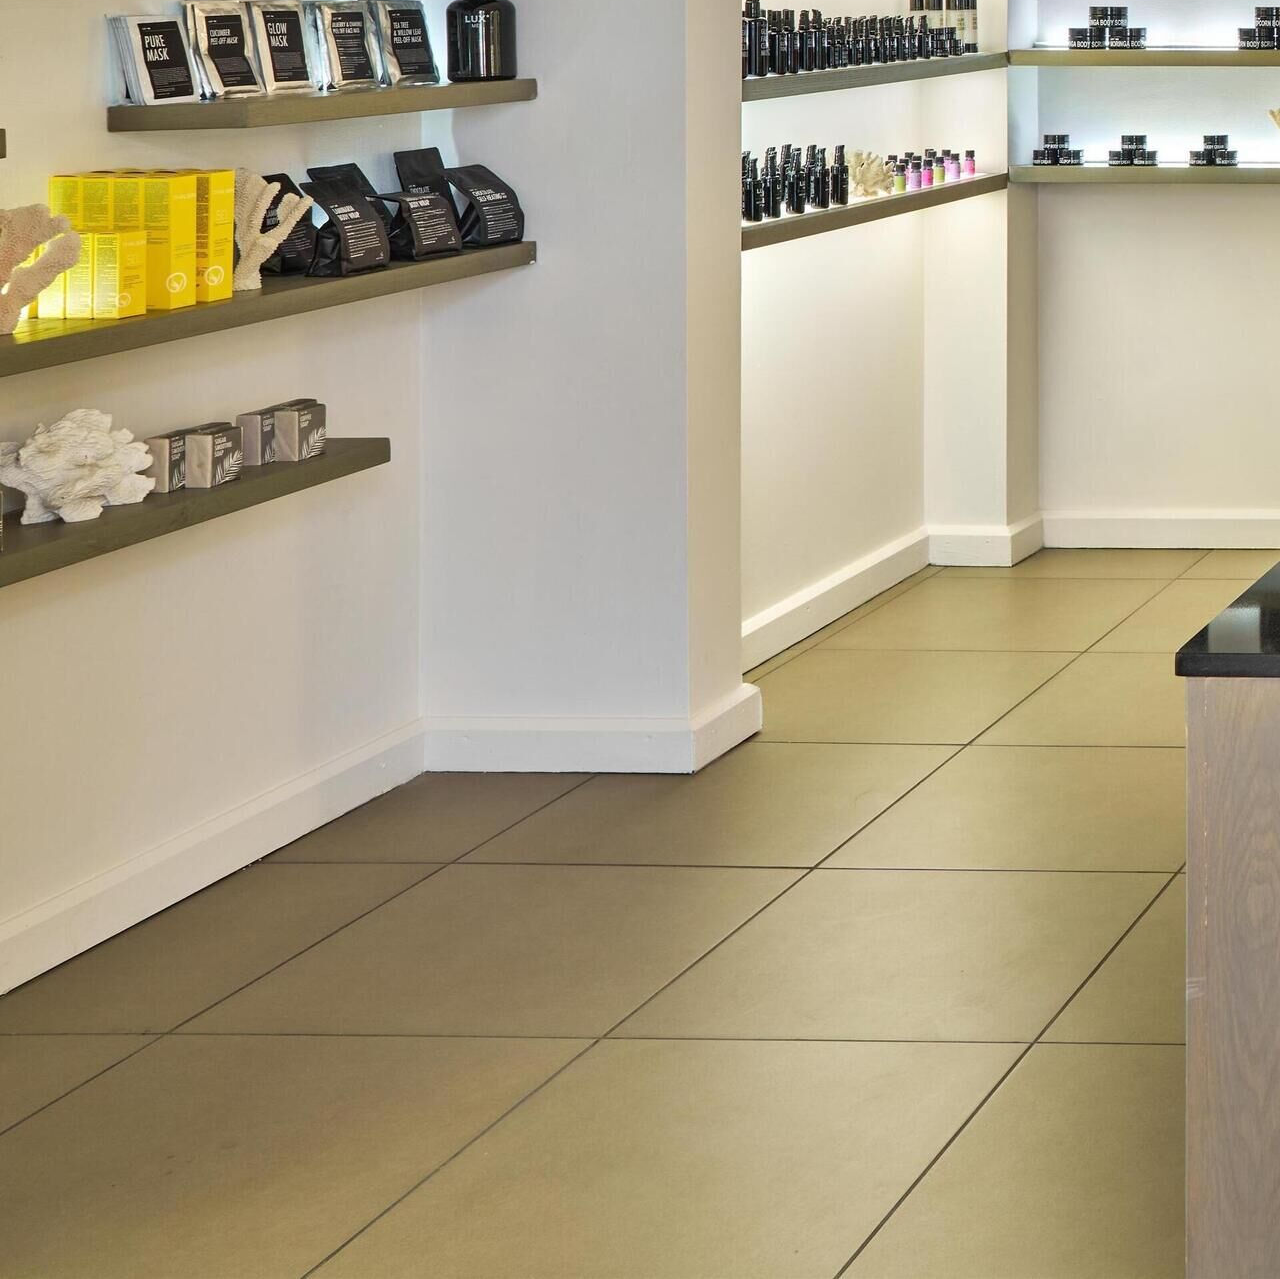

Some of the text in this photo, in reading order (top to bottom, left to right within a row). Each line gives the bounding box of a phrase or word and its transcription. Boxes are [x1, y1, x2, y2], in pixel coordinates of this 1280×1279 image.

[267, 22, 287, 35] GLOW
[144, 35, 165, 48] PURE
[226, 36, 239, 44] MASK
[270, 35, 289, 47] MASK
[393, 36, 411, 44] PEEL-OFF
[146, 48, 169, 62] MASK
